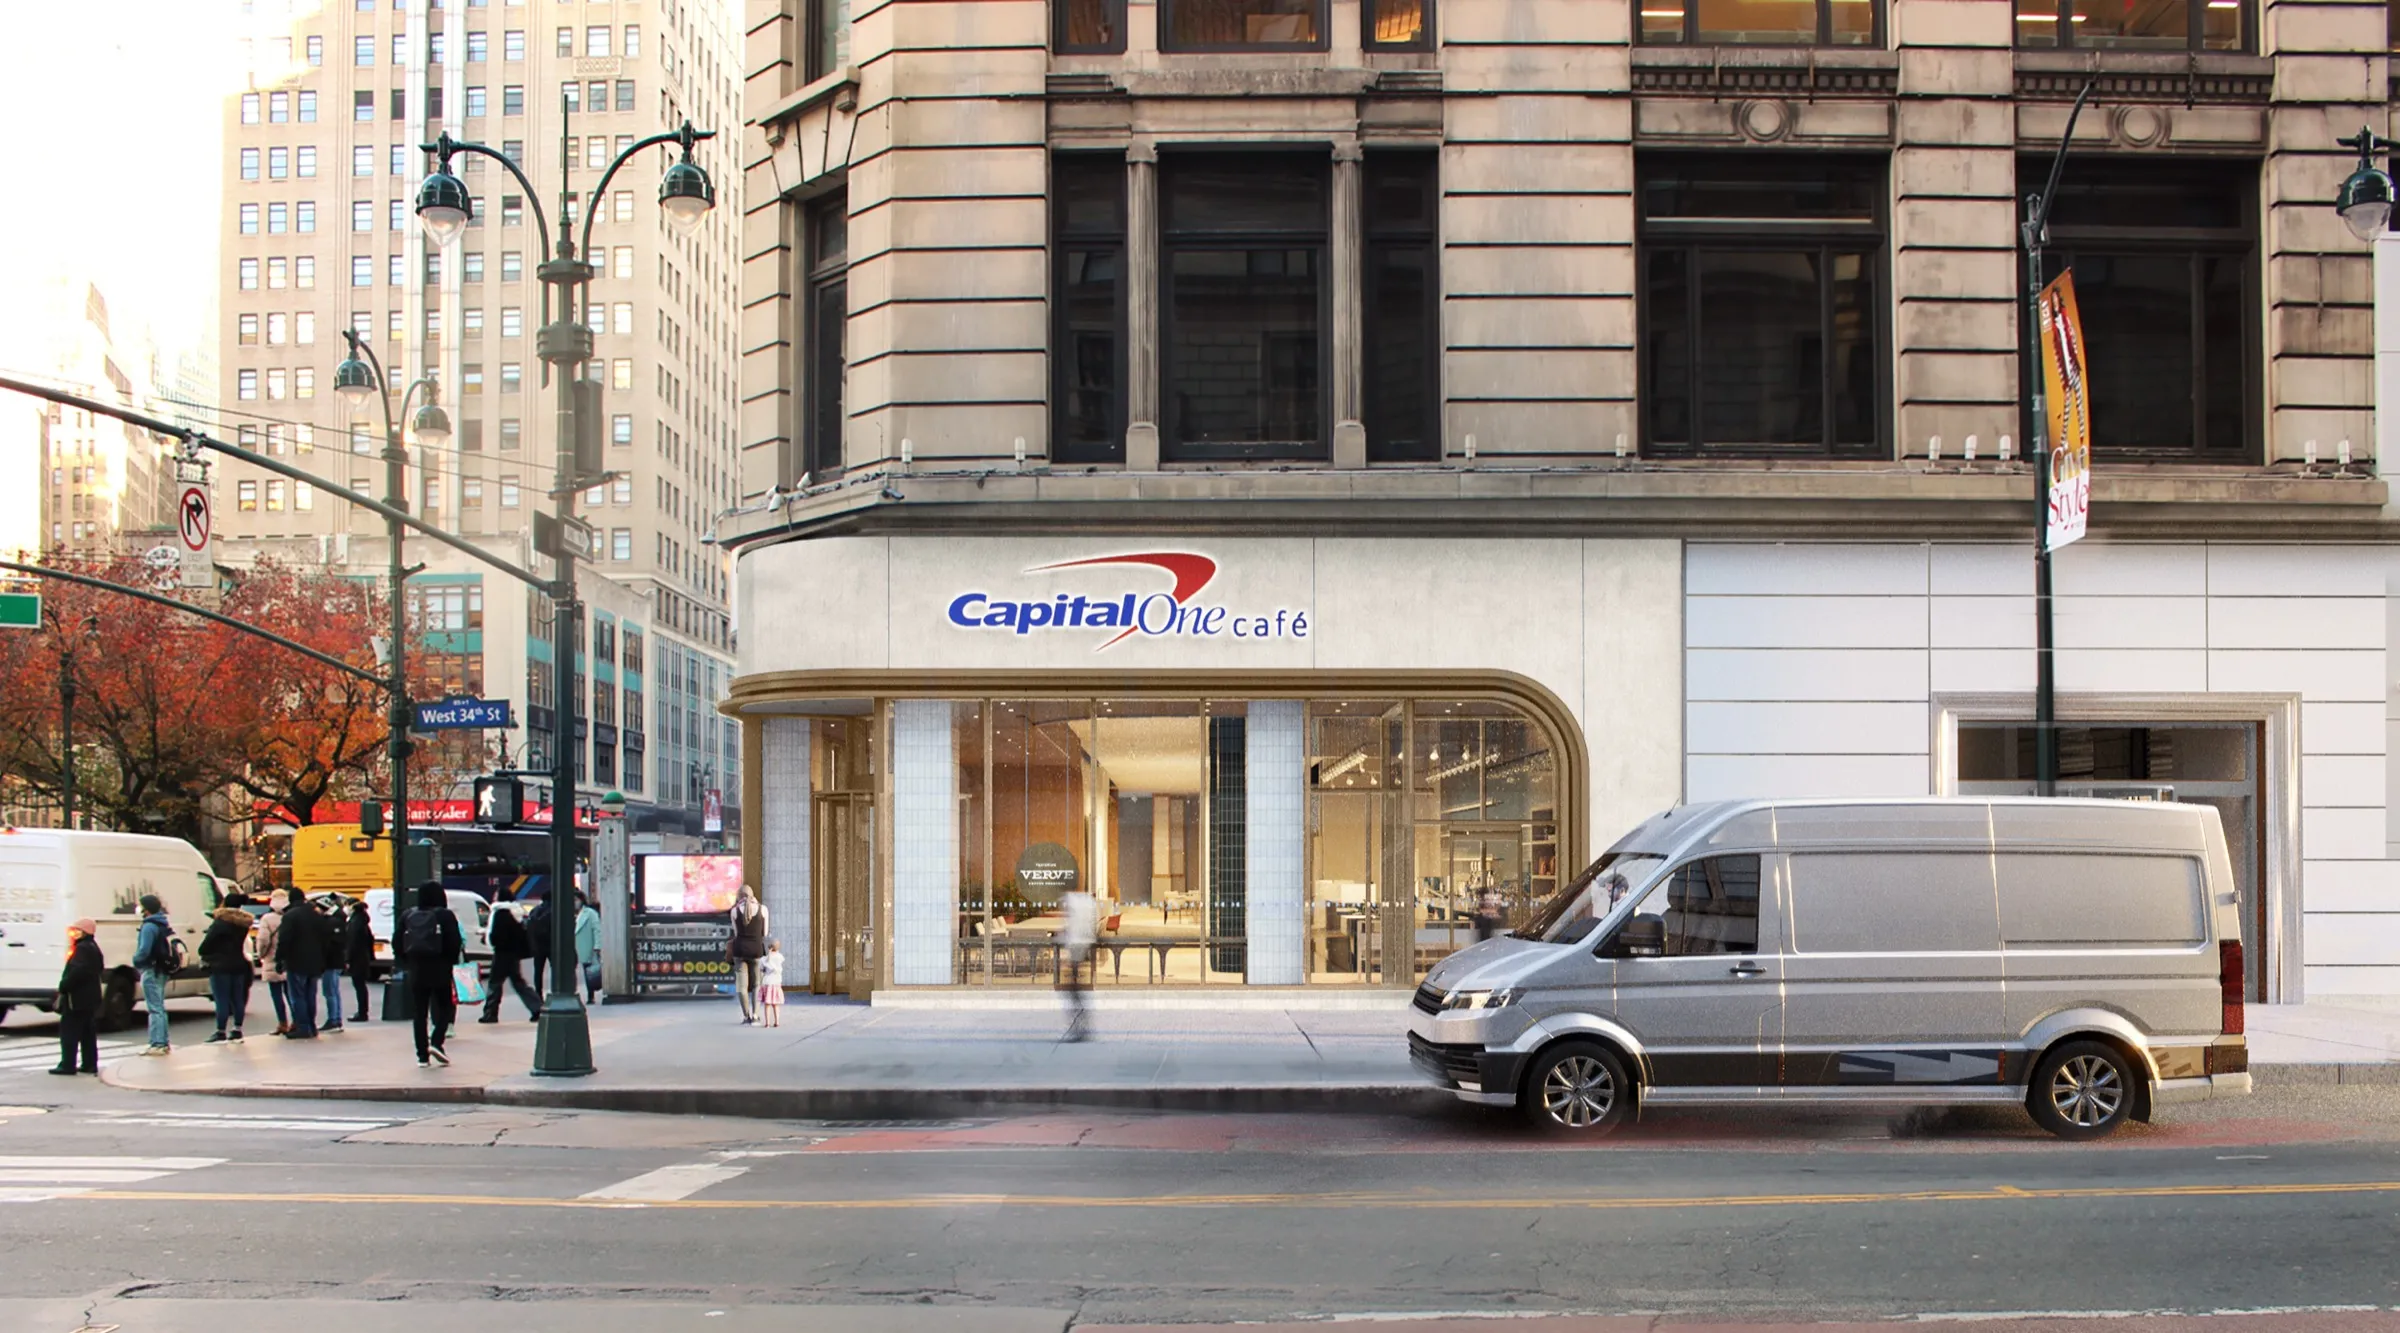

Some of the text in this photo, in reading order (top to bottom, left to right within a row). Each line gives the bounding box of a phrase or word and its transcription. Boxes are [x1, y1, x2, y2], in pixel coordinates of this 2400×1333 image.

[2048, 477, 2091, 530] Style
[1233, 610, 1308, 637] café
[422, 707, 501, 724] West 34th St
[1020, 870, 1074, 880] VERVE
[636, 942, 648, 952] 34
[651, 941, 716, 952] Street-Herald
[636, 952, 672, 961] Station
